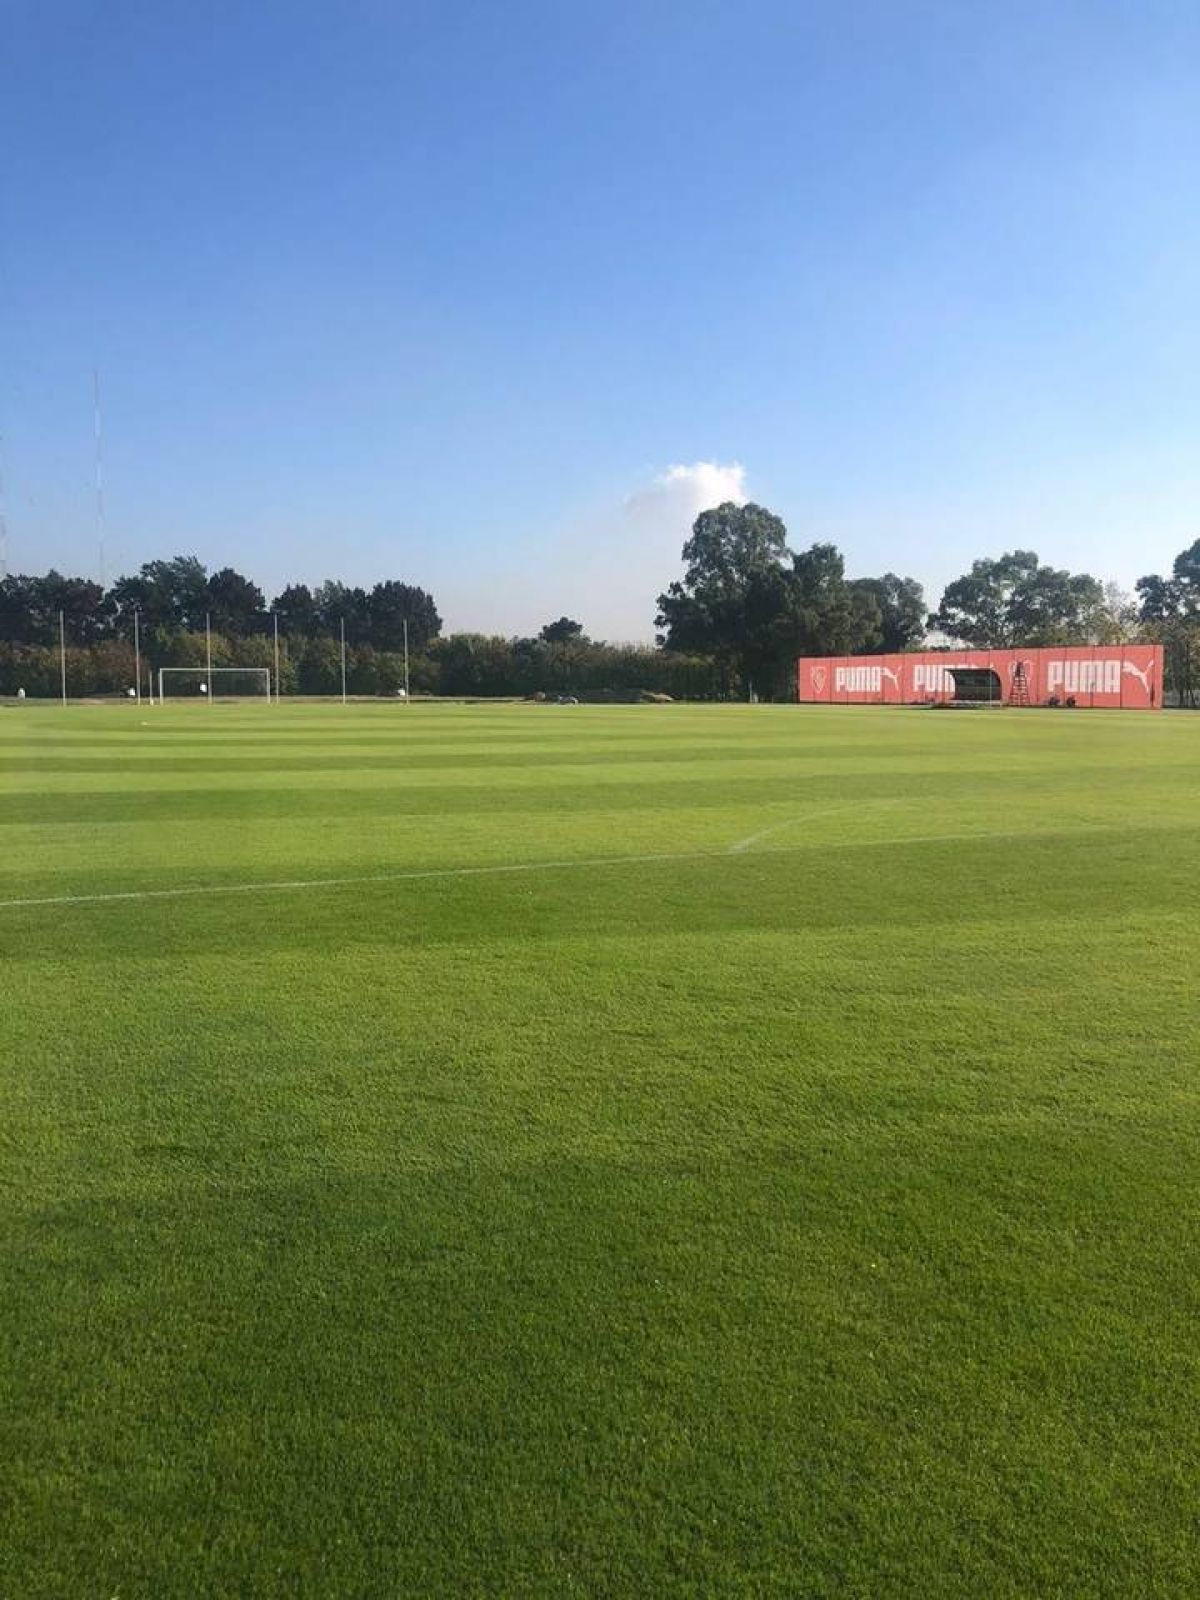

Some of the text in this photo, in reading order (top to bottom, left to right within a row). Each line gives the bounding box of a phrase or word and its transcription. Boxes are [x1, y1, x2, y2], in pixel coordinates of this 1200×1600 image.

[836, 666, 881, 693] PUMA
[913, 664, 967, 693] PUM
[1047, 661, 1121, 693] PUMA
